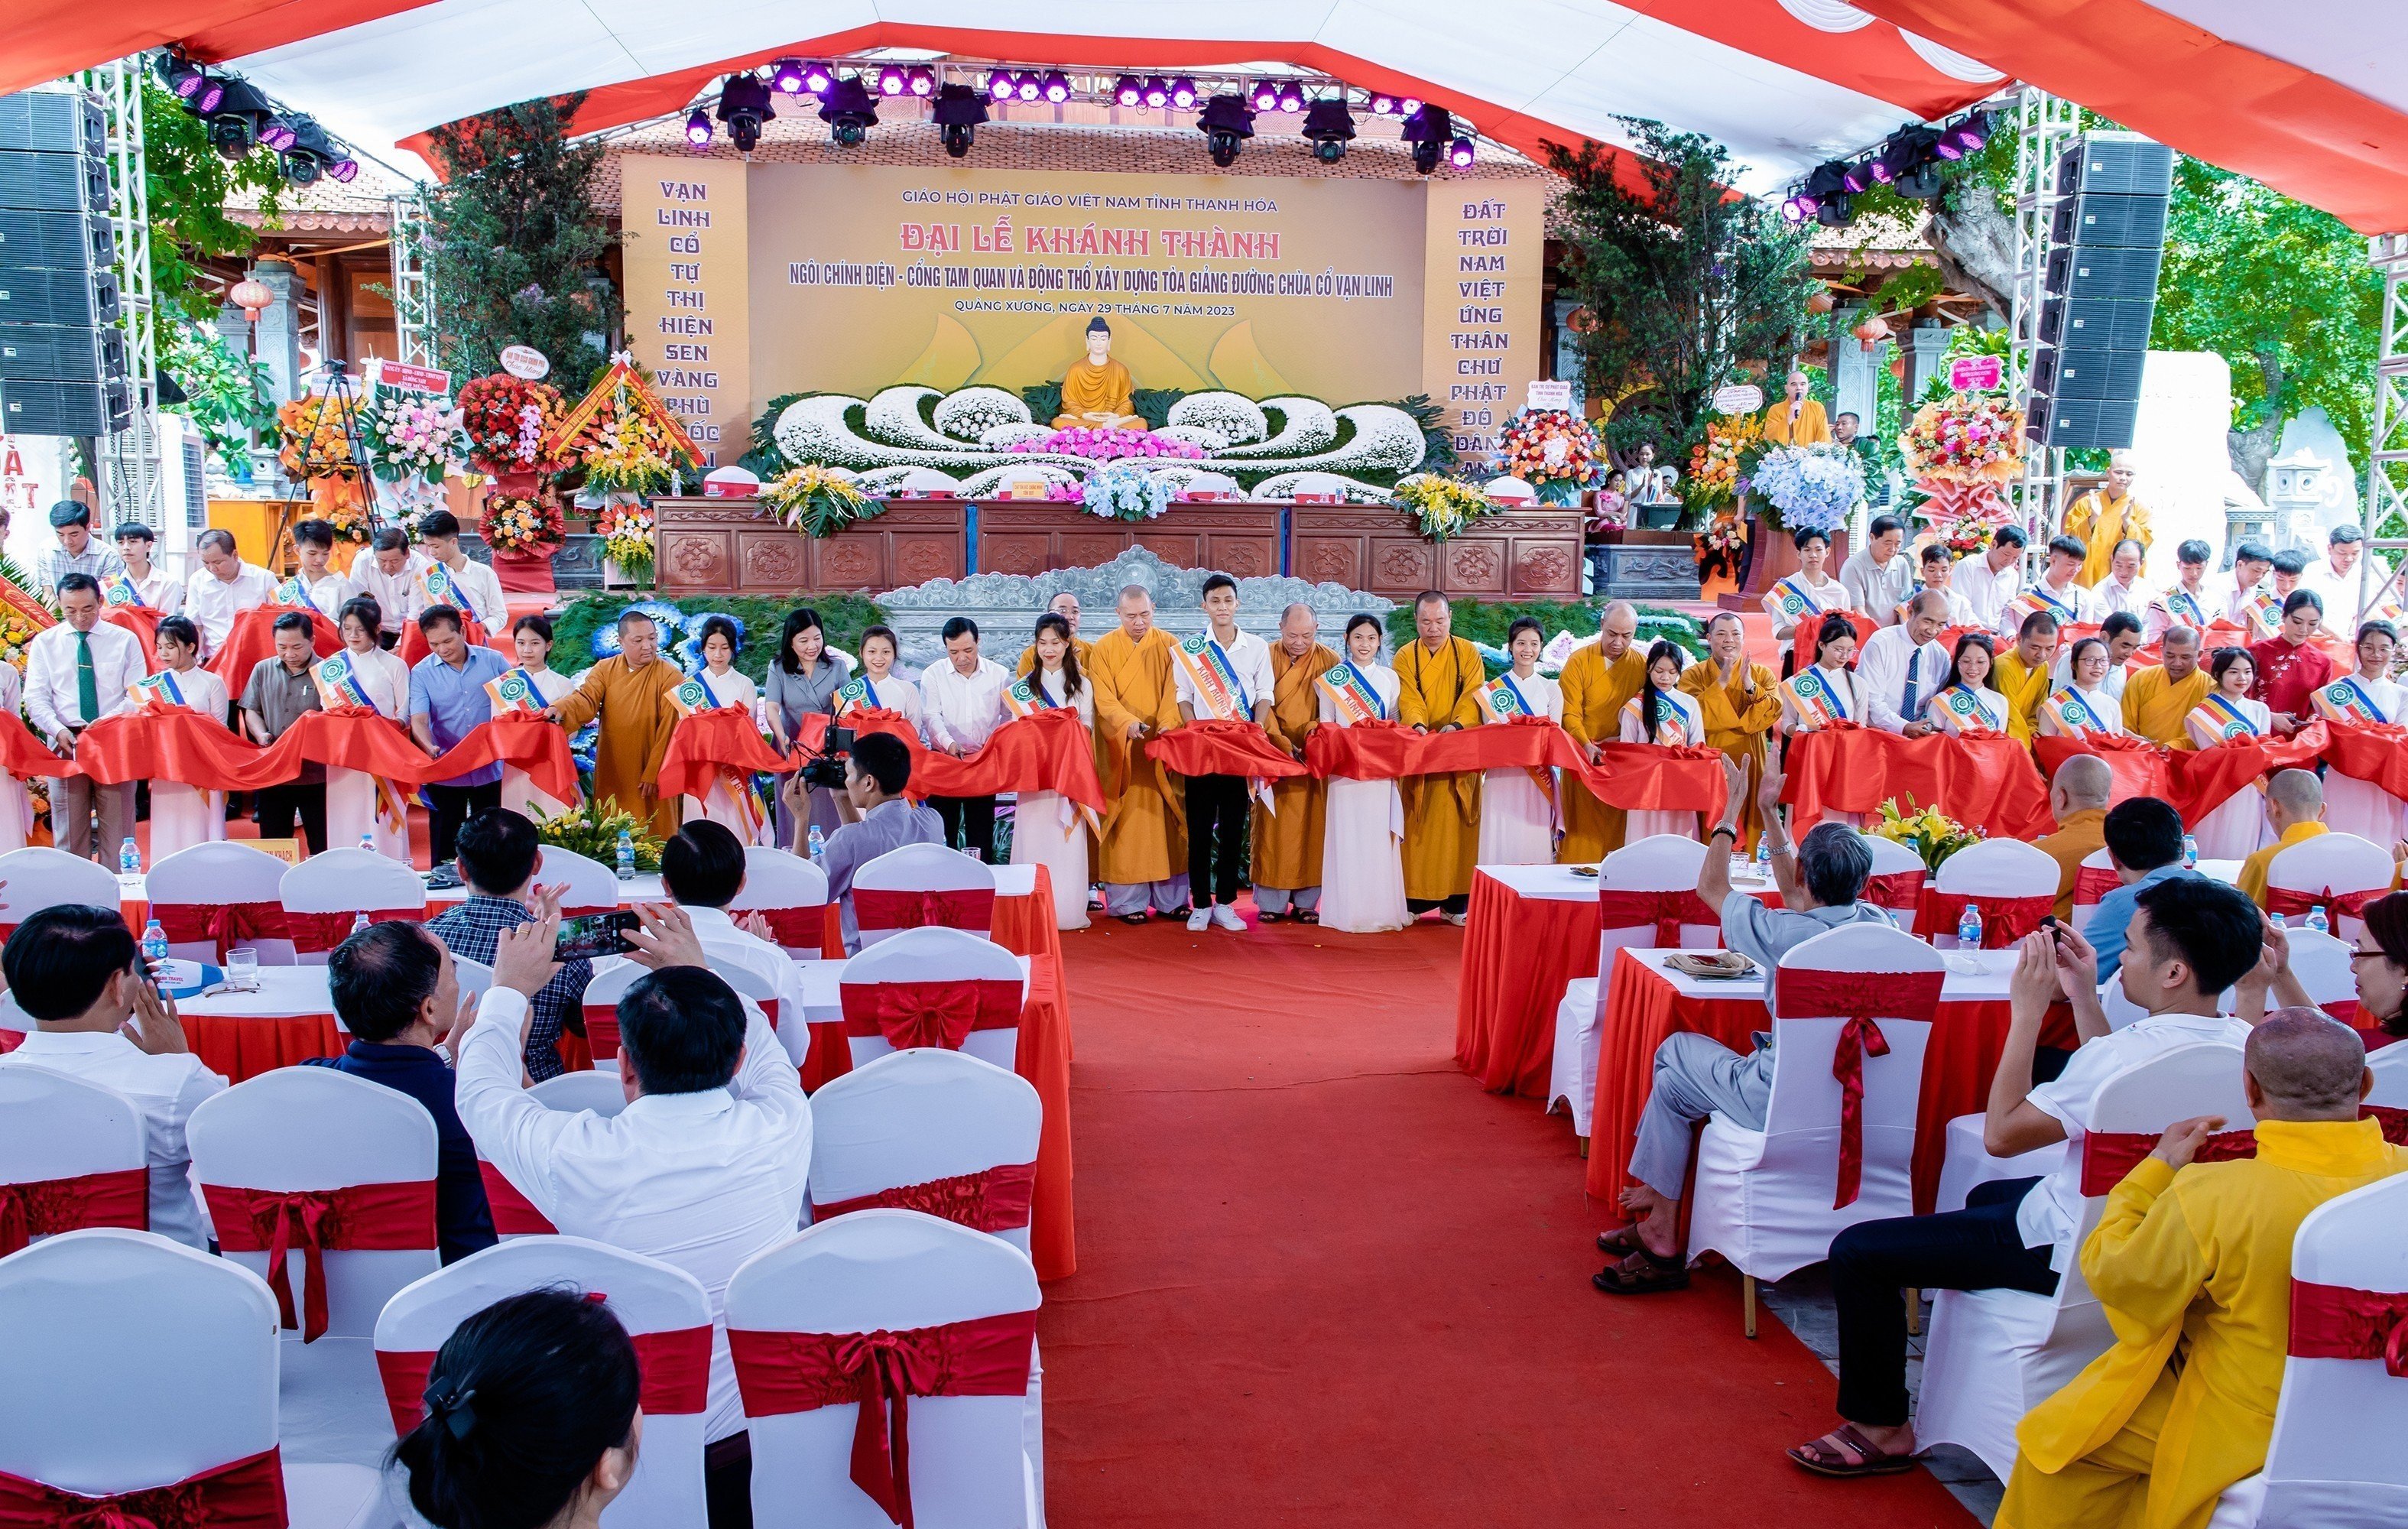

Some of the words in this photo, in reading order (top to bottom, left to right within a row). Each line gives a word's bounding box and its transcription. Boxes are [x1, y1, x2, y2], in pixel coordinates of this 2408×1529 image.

[660, 181, 706, 203] VẠN
[902, 189, 941, 203] GIÁO
[946, 189, 974, 206] HỘI
[979, 191, 1021, 207] PHẬT
[1024, 193, 1063, 206] GIÁO
[1067, 193, 1101, 209] VIỆT
[1105, 196, 1141, 208] NAM
[1144, 193, 1180, 209] TỈNH
[1185, 199, 1238, 211] THANH
[1245, 198, 1277, 212] HÓA
[658, 209, 709, 227] LINH
[1462, 198, 1506, 220] ĐẤT
[670, 232, 699, 254] CỔ
[901, 225, 959, 256] ĐẠI
[973, 216, 1012, 252] LỄ
[1027, 222, 1148, 255] KHÁNH
[1163, 226, 1279, 258] THÀNH
[1459, 226, 1507, 245] TRỜI
[670, 263, 700, 284] TỰ
[1459, 256, 1504, 271] NAM
[790, 259, 819, 284] NGÔI
[824, 261, 862, 285] CHÍNH
[865, 261, 894, 290] ĐIỆN
[907, 258, 940, 287] CỔNG
[944, 267, 969, 287] TAM
[973, 268, 1005, 291] QUAN
[1009, 265, 1025, 289] VÀ
[1028, 264, 1063, 294] ĐỘNG
[1067, 261, 1092, 291] THỔ
[1095, 265, 1120, 291] XÂY
[1124, 268, 1158, 296] DỰNG
[1162, 266, 1186, 292] TÒA
[1189, 265, 1228, 294] GIẢNG
[1232, 268, 1274, 294] ĐƯỜNG
[1278, 269, 1312, 295] CHÙA
[1316, 266, 1332, 296] CỔ
[1335, 275, 1361, 300] VẠN
[1365, 276, 1392, 297] LINH
[1459, 278, 1504, 300] VIỆT
[667, 291, 704, 311] THỊ
[955, 298, 1001, 312] QUẢNG
[1005, 300, 1055, 313] XƯƠNG,
[1060, 300, 1094, 313] NGÀY
[1095, 304, 1112, 313] 29
[1115, 302, 1159, 314] THÁNG
[1163, 305, 1170, 314] 7
[1174, 303, 1202, 315] NĂM
[1206, 306, 1235, 316] 2023
[1459, 302, 1502, 323] ỨNG
[659, 316, 712, 336] HIỆN
[1451, 330, 1508, 349] THÂN
[666, 344, 708, 361] SEN
[1458, 357, 1502, 375] CHƯ
[657, 368, 718, 388] VÀNG
[1451, 381, 1507, 404] PHẬT
[666, 395, 711, 414] PHÙ
[1462, 407, 1492, 429] ĐỘ
[1455, 433, 1498, 451] DÂN
[1196, 665, 1215, 688] KÍNH
[1213, 662, 1224, 674] BAN
[1361, 693, 1370, 703] BAN
